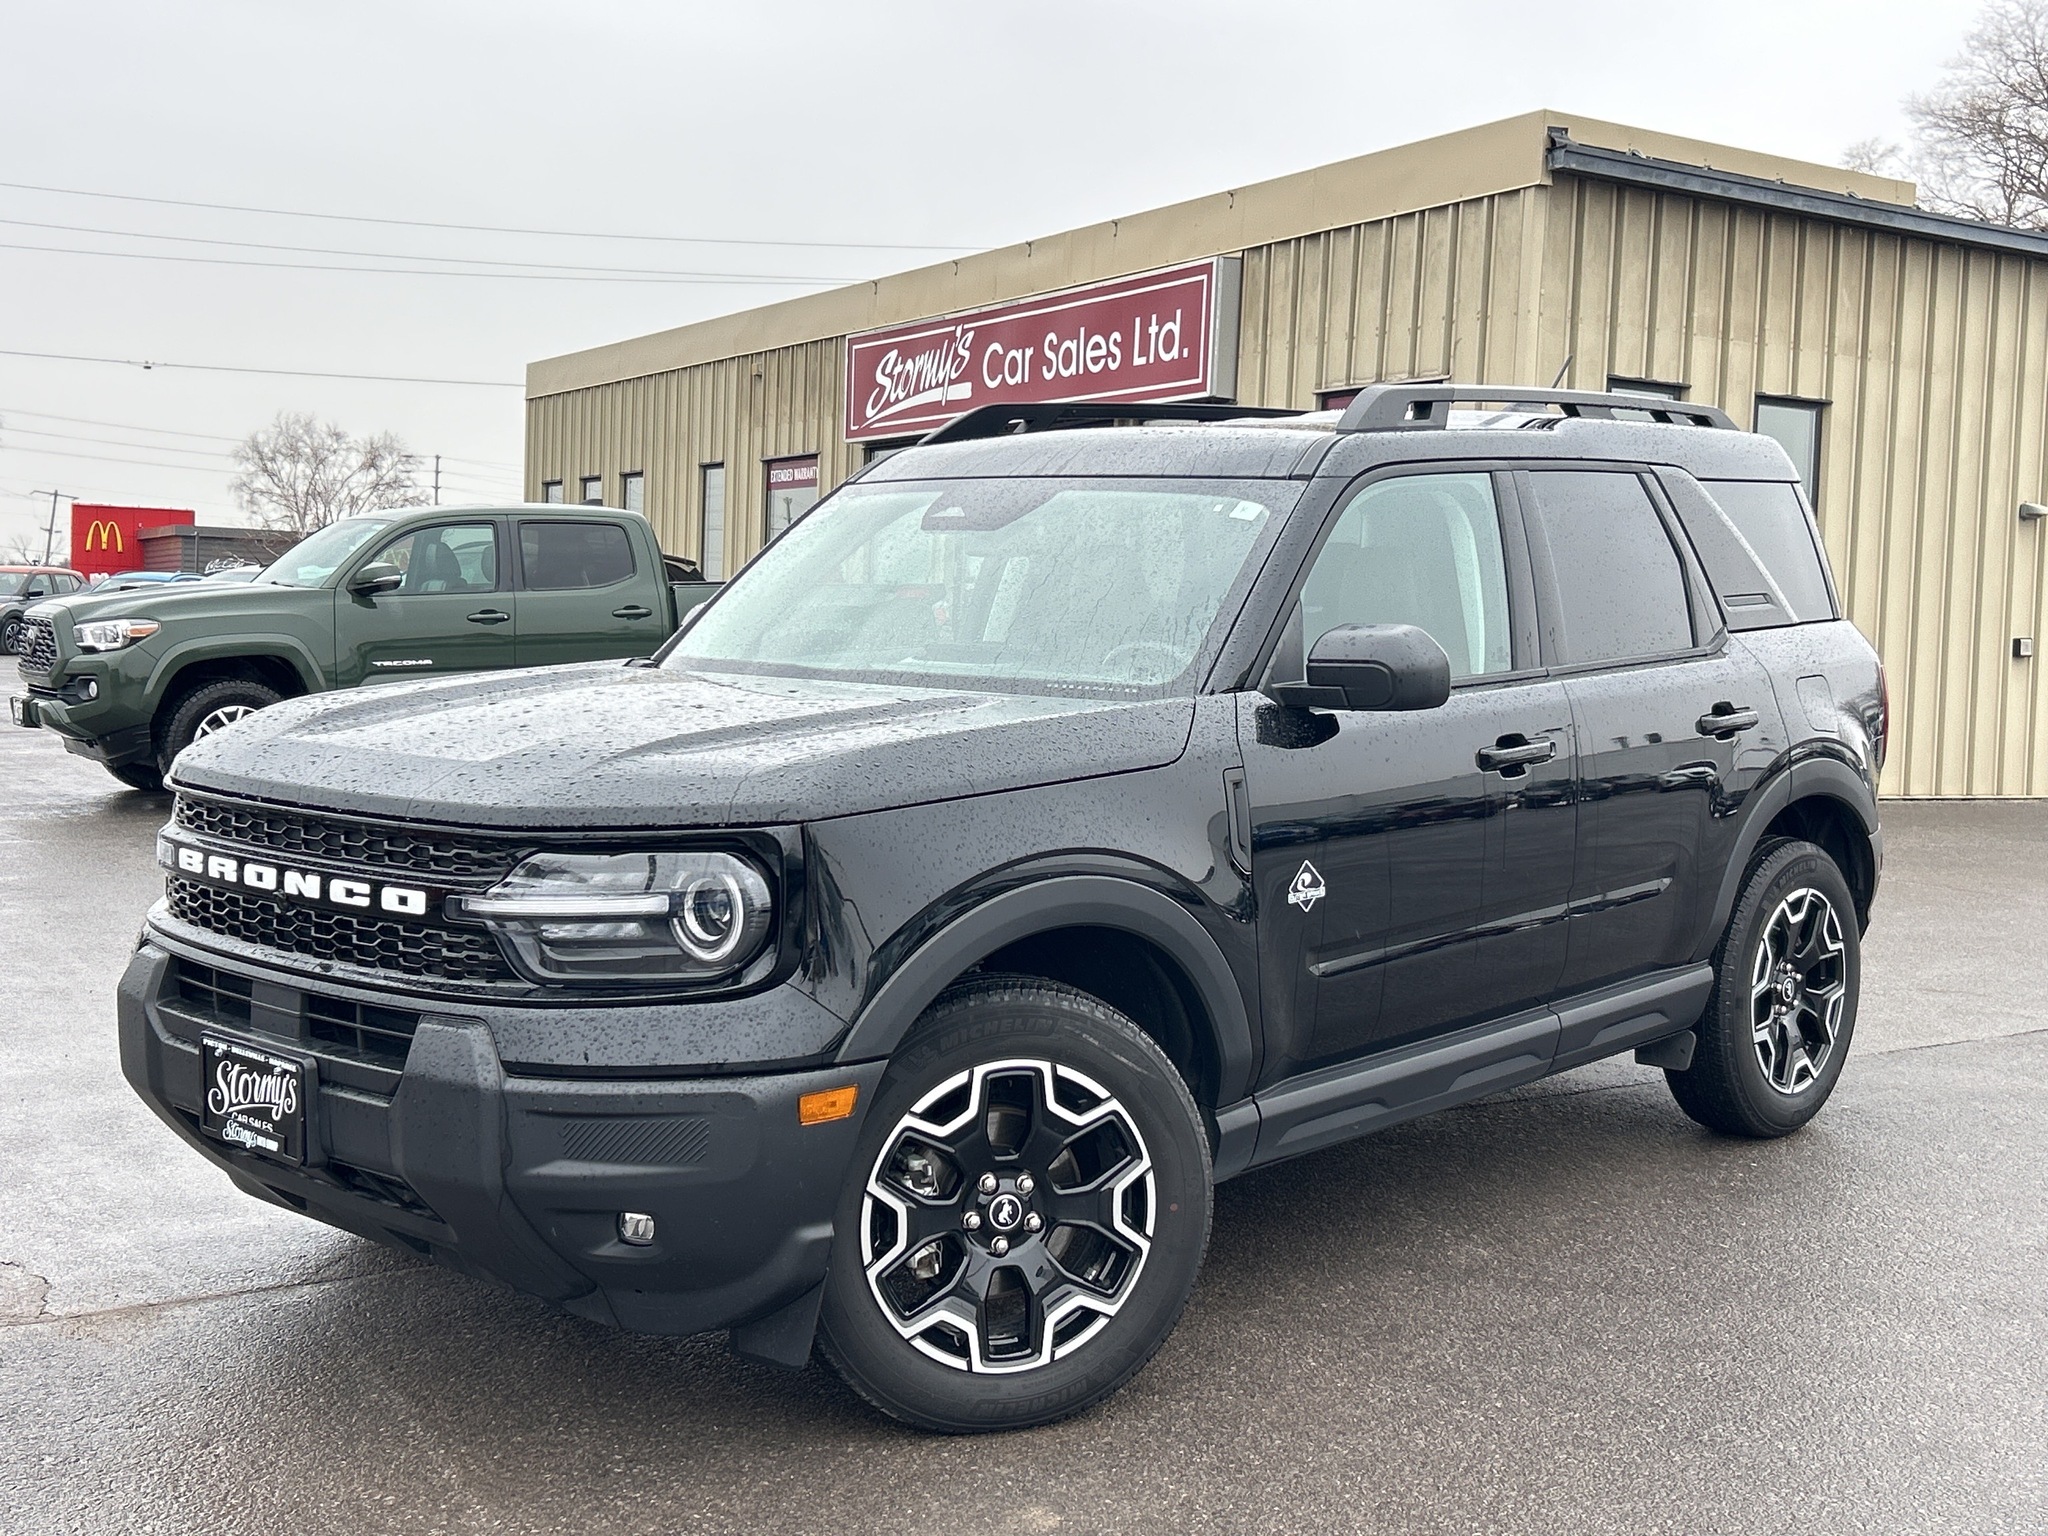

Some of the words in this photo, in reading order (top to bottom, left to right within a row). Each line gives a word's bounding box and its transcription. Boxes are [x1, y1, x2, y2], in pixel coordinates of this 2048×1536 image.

[865, 323, 975, 407] Stormy's
[982, 342, 1034, 390] Car
[1042, 327, 1122, 382] Sales
[1132, 309, 1189, 367] Ltd.
[770, 469, 794, 483] EXTENDED
[372, 659, 433, 667] TACOMA
[178, 847, 426, 915] BRONCO
[207, 1060, 297, 1121] Stormy's
[231, 1112, 248, 1123] CAR
